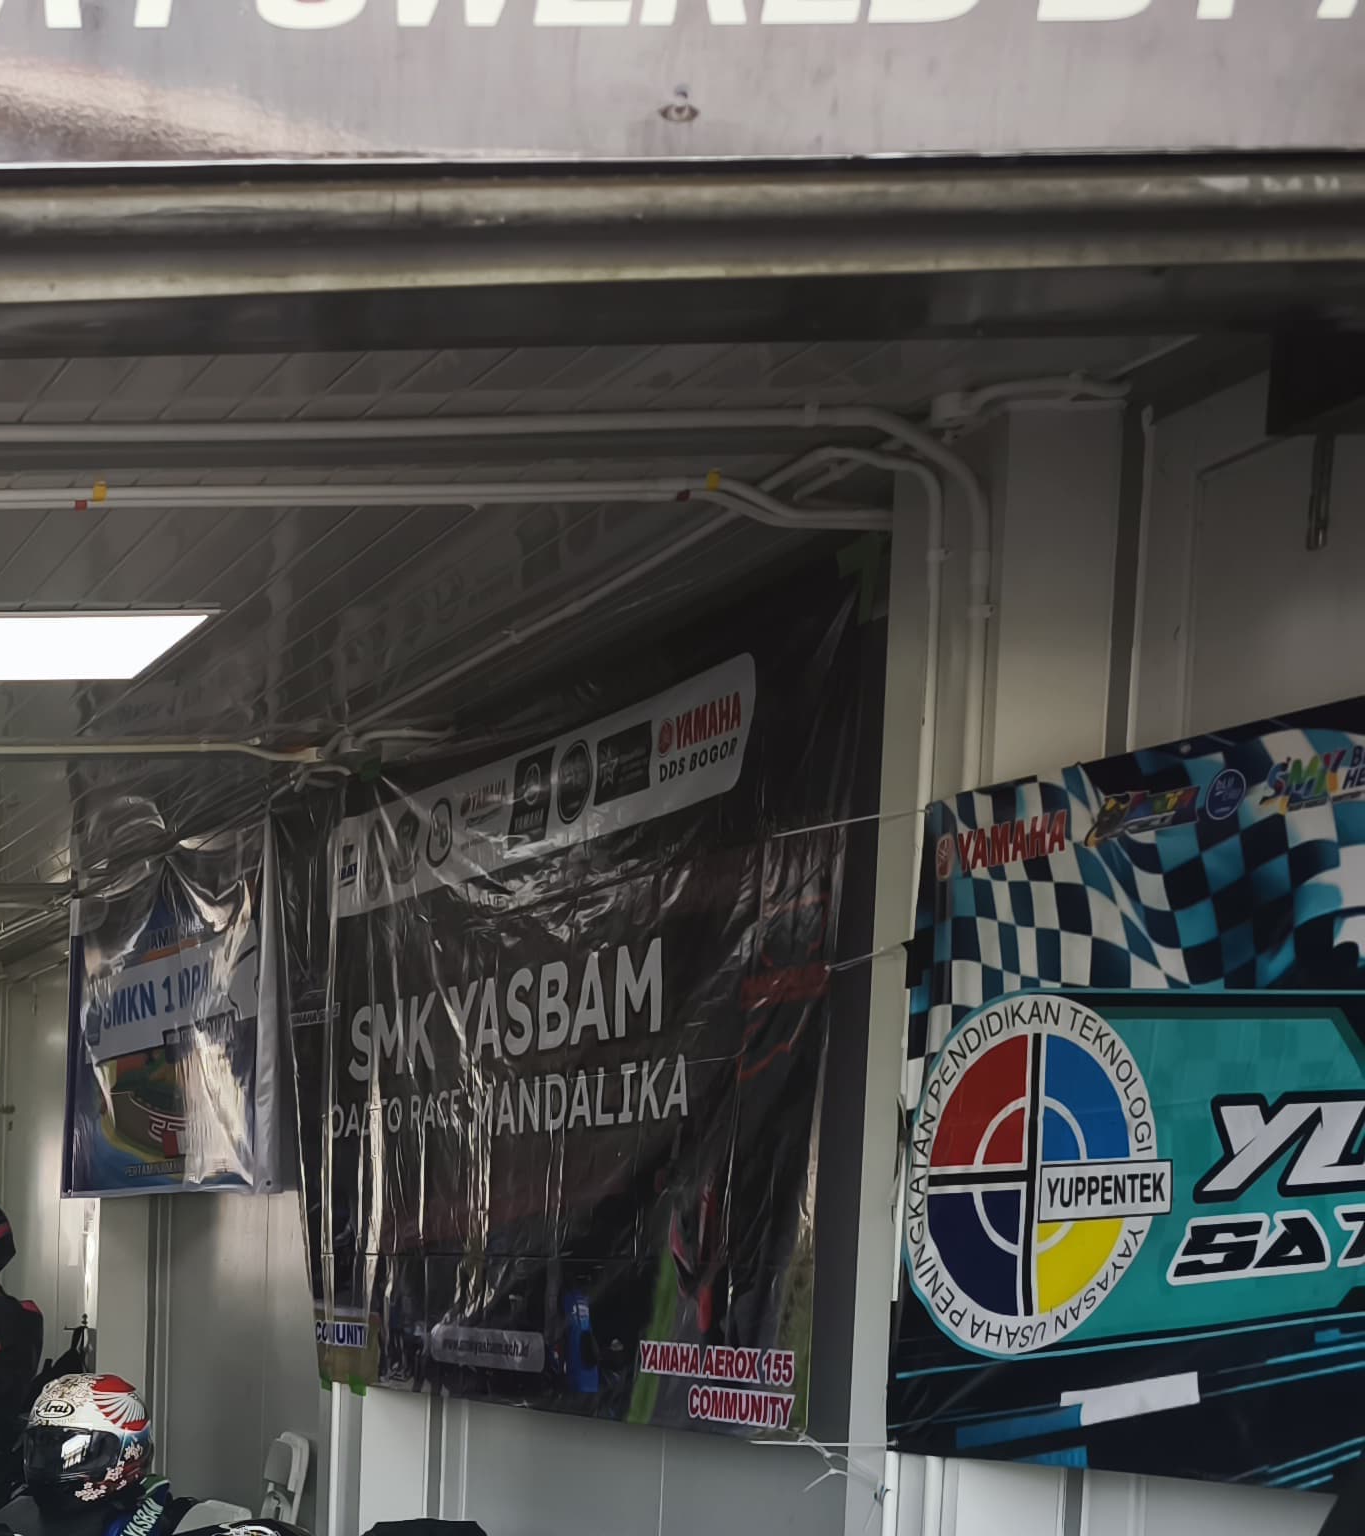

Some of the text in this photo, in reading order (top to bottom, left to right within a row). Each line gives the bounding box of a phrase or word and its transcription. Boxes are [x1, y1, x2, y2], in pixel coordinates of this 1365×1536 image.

[672, 692, 743, 750] YAMAHA
[656, 738, 739, 785] DDS BOGOR
[958, 809, 1068, 873] YAMAHA
[163, 974, 175, 1013] 1
[349, 937, 664, 1082] SMK YASBAM
[470, 1053, 690, 1140] MANDALIKA
[928, 1002, 1062, 1101] PENDIDIKAN
[1069, 1004, 1152, 1154] TEKNOLOGI
[1046, 1172, 1167, 1208] YUPPENTEK
[969, 1225, 1146, 1349] YAYASAN USAHA
[640, 1341, 795, 1386] YAMAHA AEROX 155
[38, 1402, 71, 1417] Arai
[688, 1386, 793, 1428] COMMUNITY
